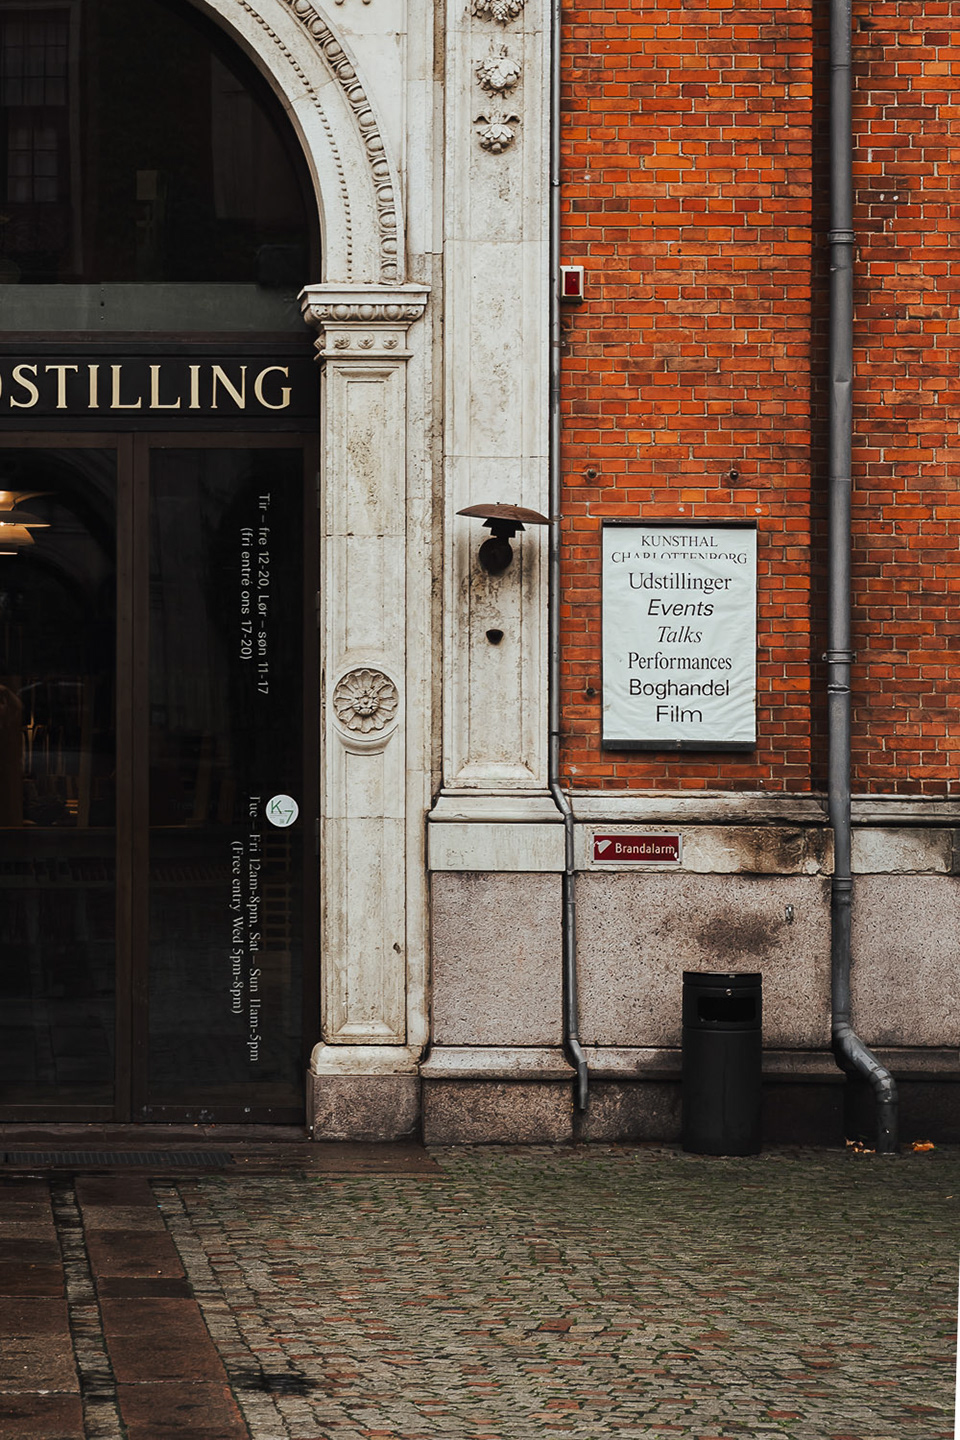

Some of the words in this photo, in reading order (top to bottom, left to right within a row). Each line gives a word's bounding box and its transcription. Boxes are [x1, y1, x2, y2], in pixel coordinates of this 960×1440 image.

[258, 493, 271, 511] Tir
[240, 527, 254, 547] (fri
[258, 527, 271, 546] fre
[641, 535, 718, 547] KUNSTHAL
[241, 551, 253, 586] entré
[256, 551, 270, 590] 12-20,
[628, 572, 732, 595] Udstillinger
[240, 590, 250, 615] ons
[257, 595, 270, 617] Lør
[647, 598, 715, 617] Events
[239, 619, 253, 660] 17-20)
[257, 631, 267, 656] søn
[658, 625, 703, 643] Talks
[628, 651, 733, 670] Performances
[257, 661, 269, 695] 11-17
[629, 678, 730, 700] Boghandel
[656, 705, 703, 723] Film
[249, 834, 261, 852] Fri
[615, 843, 675, 854] Brandalarm
[230, 840, 244, 875] (Free
[228, 878, 242, 912] entry
[232, 916, 244, 944] Wed
[249, 932, 261, 952] Sat
[229, 948, 244, 1014] 5pm-8pm)
[249, 968, 261, 992] Sun
